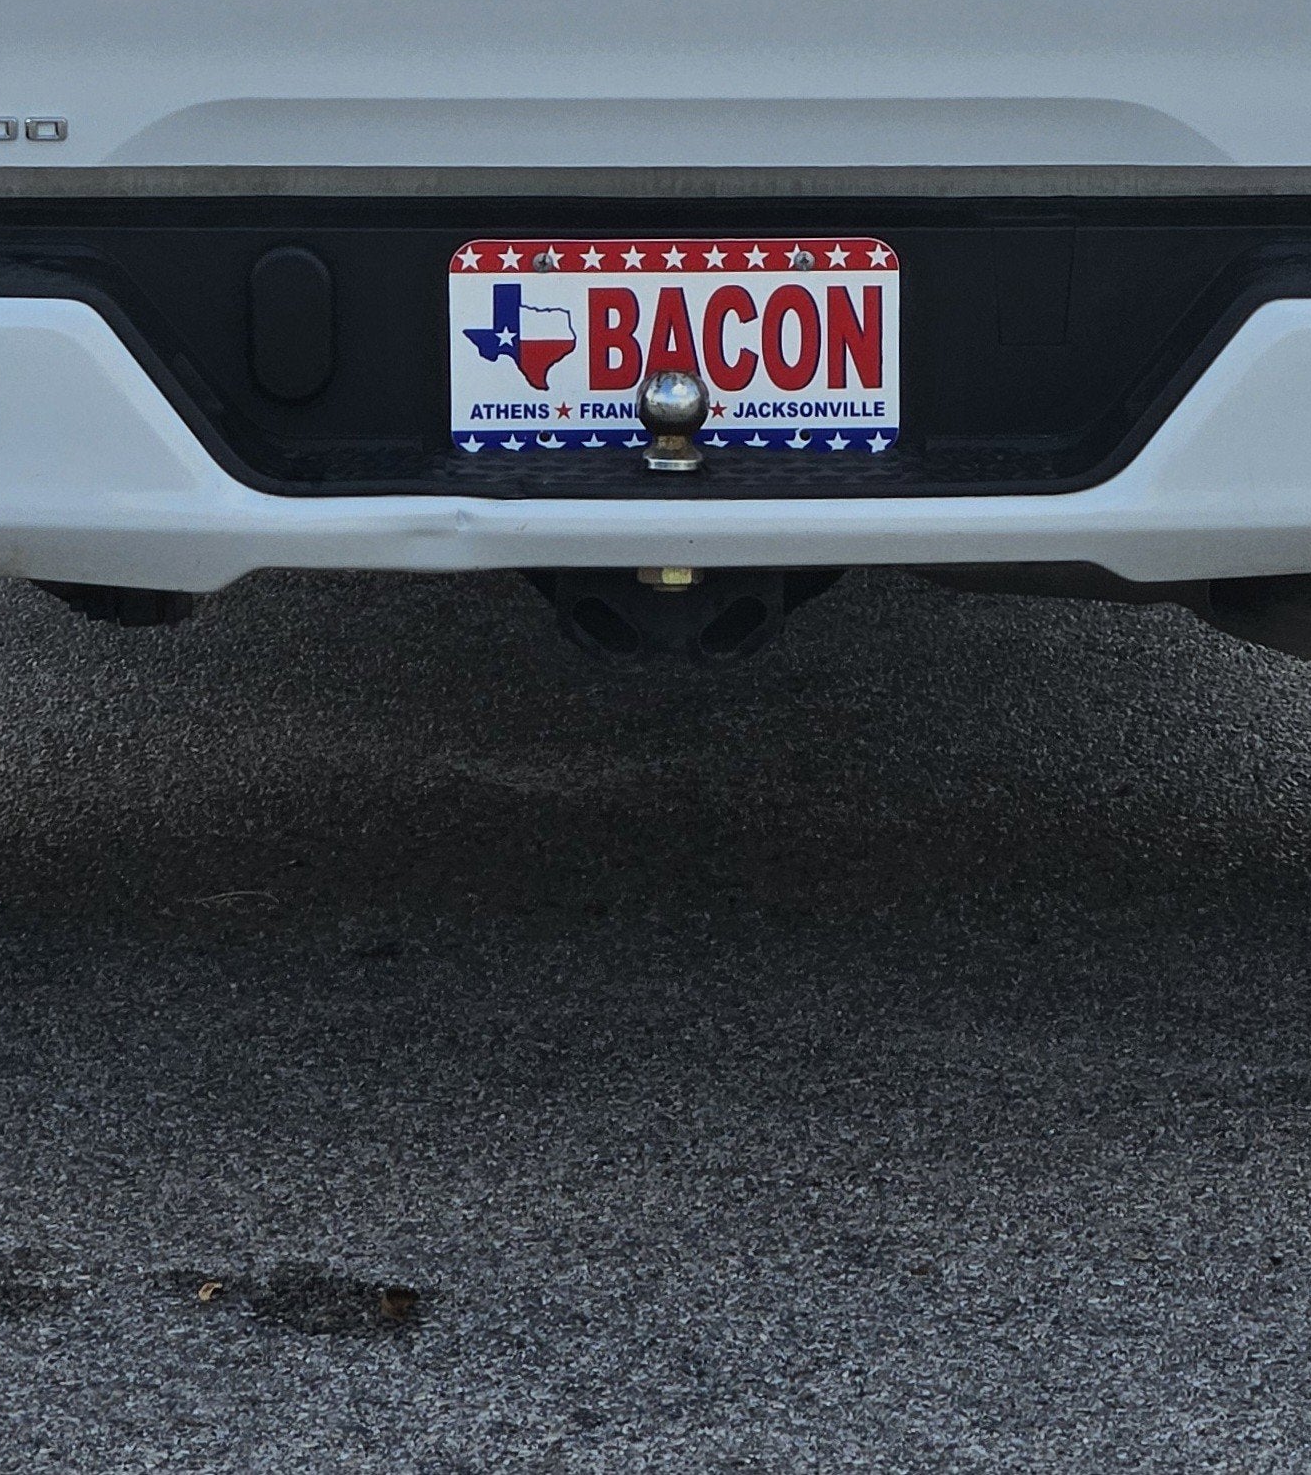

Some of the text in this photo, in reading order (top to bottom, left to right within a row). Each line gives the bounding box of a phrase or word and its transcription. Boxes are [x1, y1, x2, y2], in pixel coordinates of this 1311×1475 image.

[588, 284, 883, 392] BACON
[470, 403, 550, 420] ATHENS
[733, 401, 885, 419] JACKSONVILLE
